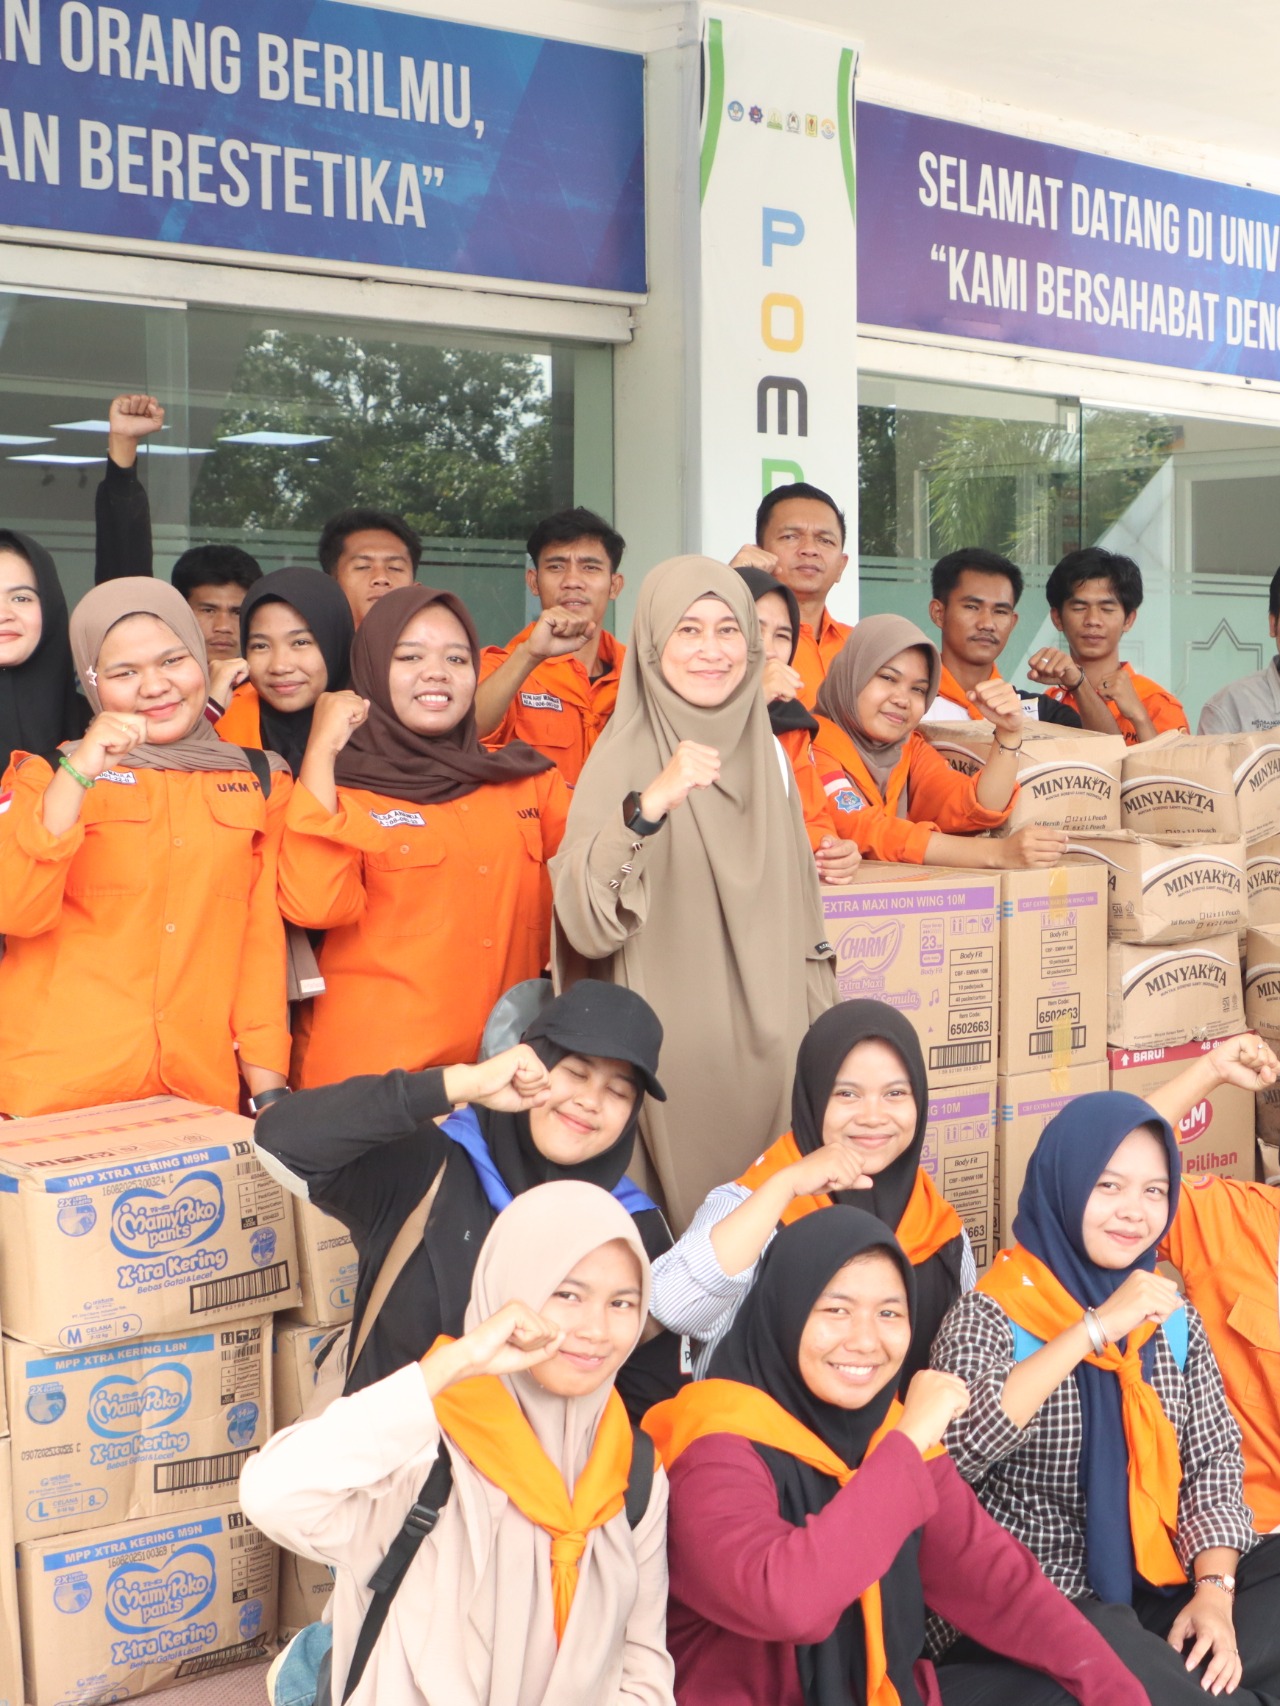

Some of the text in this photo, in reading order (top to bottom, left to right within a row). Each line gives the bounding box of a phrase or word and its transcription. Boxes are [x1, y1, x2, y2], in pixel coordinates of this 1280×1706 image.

[0, 0, 484, 139] N ORANG BERILMU,
[79, 119, 444, 228] BERESTETIKA”
[918, 151, 1064, 230] SELAMAT
[1071, 184, 1180, 255] DATANG
[1189, 209, 1213, 260] DI
[931, 243, 1029, 312] “KAMI
[1036, 263, 1218, 341] BERSAHABAT
[1125, 732, 1138, 742] PK
[217, 783, 249, 792] UKM
[1031, 775, 1112, 800] MINYAKITA
[1123, 790, 1214, 814] MINYAKITA
[1163, 869, 1241, 897] MINYAKITA
[823, 894, 966, 913] EXTRA MAXI NON WING 10M
[841, 935, 889, 960] CHARM
[922, 935, 937, 949] 23
[839, 977, 883, 990] Extra Maxi
[1145, 963, 1227, 997] MINYAKITA
[951, 1021, 989, 1035] 6502663
[1133, 1041, 1211, 1063] BARU! 48
[942, 1102, 961, 1114] 10M
[1179, 1102, 1206, 1131] GM
[68, 1152, 210, 1188] MPP XTRA KERING M9N
[954, 1158, 969, 1167] Body
[148, 1224, 191, 1248] pants
[117, 1248, 228, 1289] X-tra Kering
[137, 1284, 162, 1294] Bebas
[340, 1288, 350, 1304] L
[67, 1322, 129, 1345] M CELANA 9
[55, 1342, 187, 1370] MPP XTRA KERING L8N
[90, 1431, 190, 1465] X-tra Kering
[38, 1495, 95, 1517] L CELANA 8
[65, 1525, 202, 1564] MPP XTRA KERING M9N
[142, 1598, 184, 1624] pants
[111, 1622, 218, 1665] X-tra Kering
